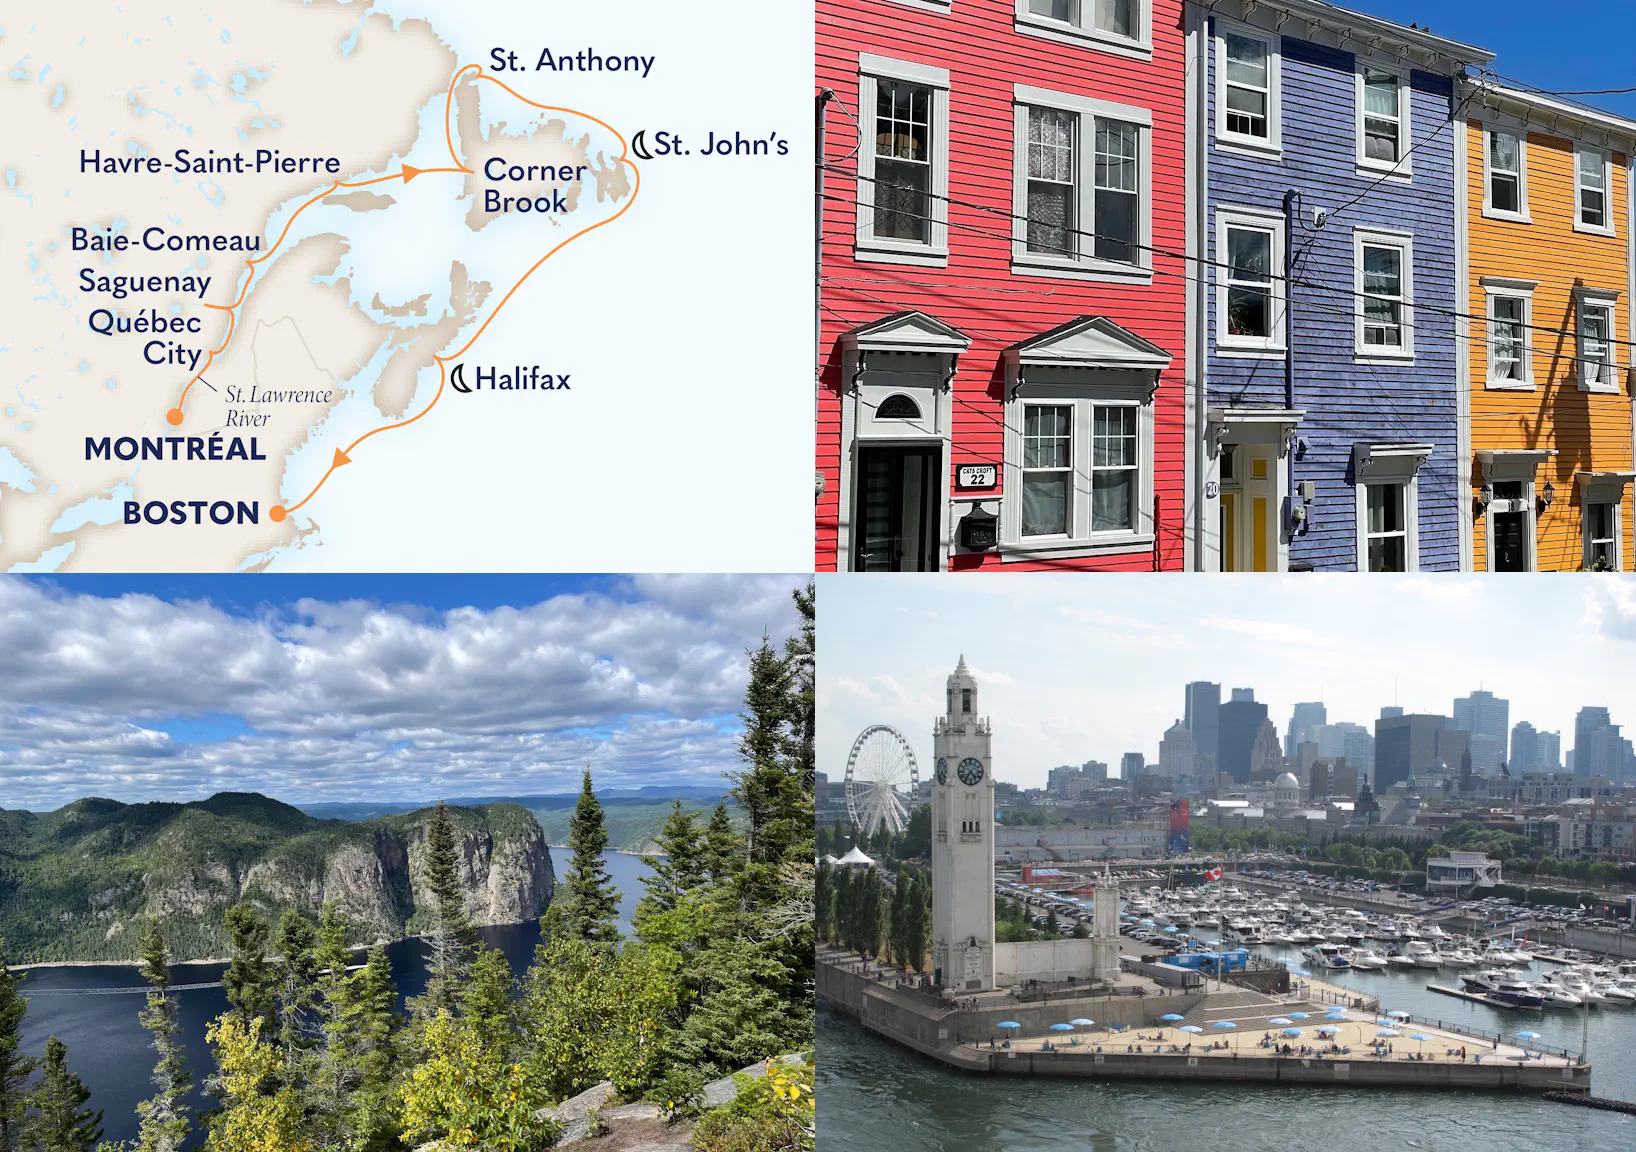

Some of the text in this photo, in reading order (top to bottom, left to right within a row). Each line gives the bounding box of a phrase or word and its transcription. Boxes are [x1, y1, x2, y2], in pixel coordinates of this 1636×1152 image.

[489, 47, 656, 79] St. Anthony
[654, 131, 789, 156] St. John’s
[80, 148, 341, 174] Havre-Saint-Pierre
[484, 157, 588, 182] Corner
[484, 188, 568, 213] Brook
[72, 226, 260, 252] Baie-Comeau
[79, 267, 212, 300] Saguenay
[88, 308, 201, 337] Québec
[143, 340, 203, 372] City
[476, 365, 571, 391] Halifax
[225, 385, 332, 403] St. Lawrence
[225, 409, 271, 427] River
[85, 431, 267, 461] MONTRÉAL
[970, 474, 985, 485] 22
[1207, 482, 1219, 496] 20
[123, 500, 259, 525] BOSTON
